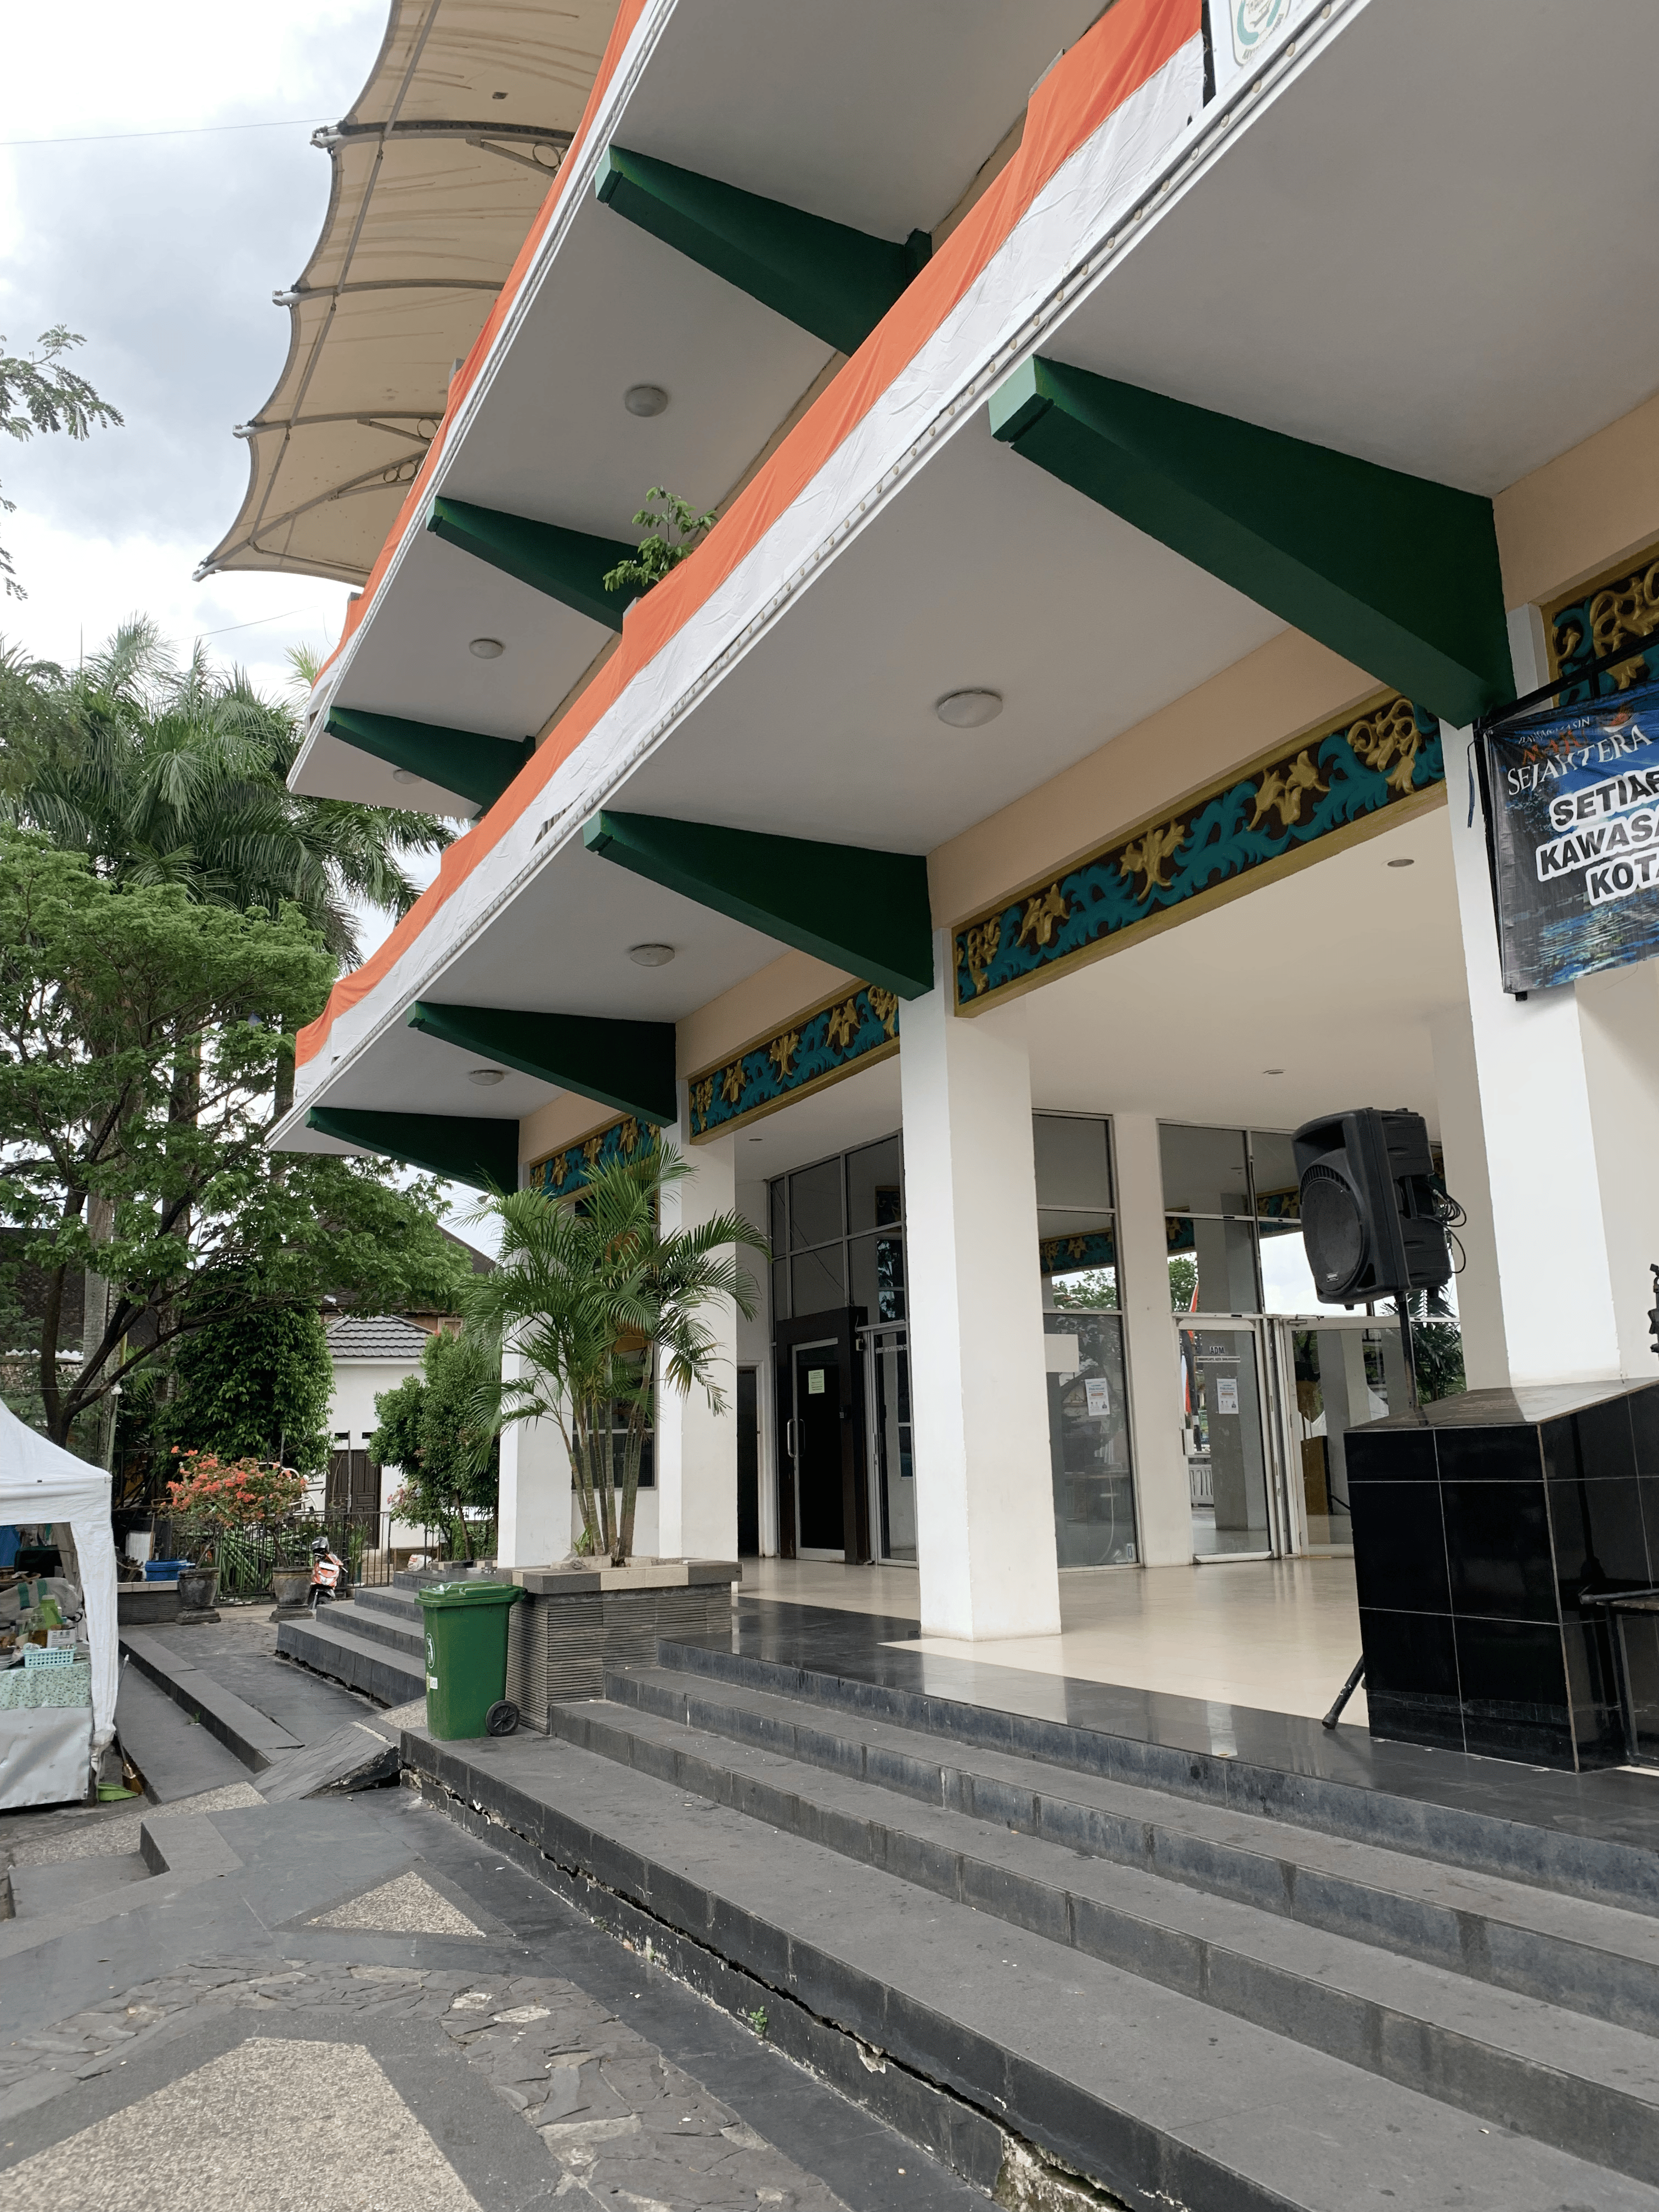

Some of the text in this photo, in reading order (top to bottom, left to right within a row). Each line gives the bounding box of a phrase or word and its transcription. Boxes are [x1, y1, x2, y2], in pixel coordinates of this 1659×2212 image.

[1508, 724, 1653, 795] SEJAHTERA
[1540, 814, 1659, 876] KAWAS
[1590, 853, 1659, 900] KOT
[1209, 1346, 1225, 1354] ADM
